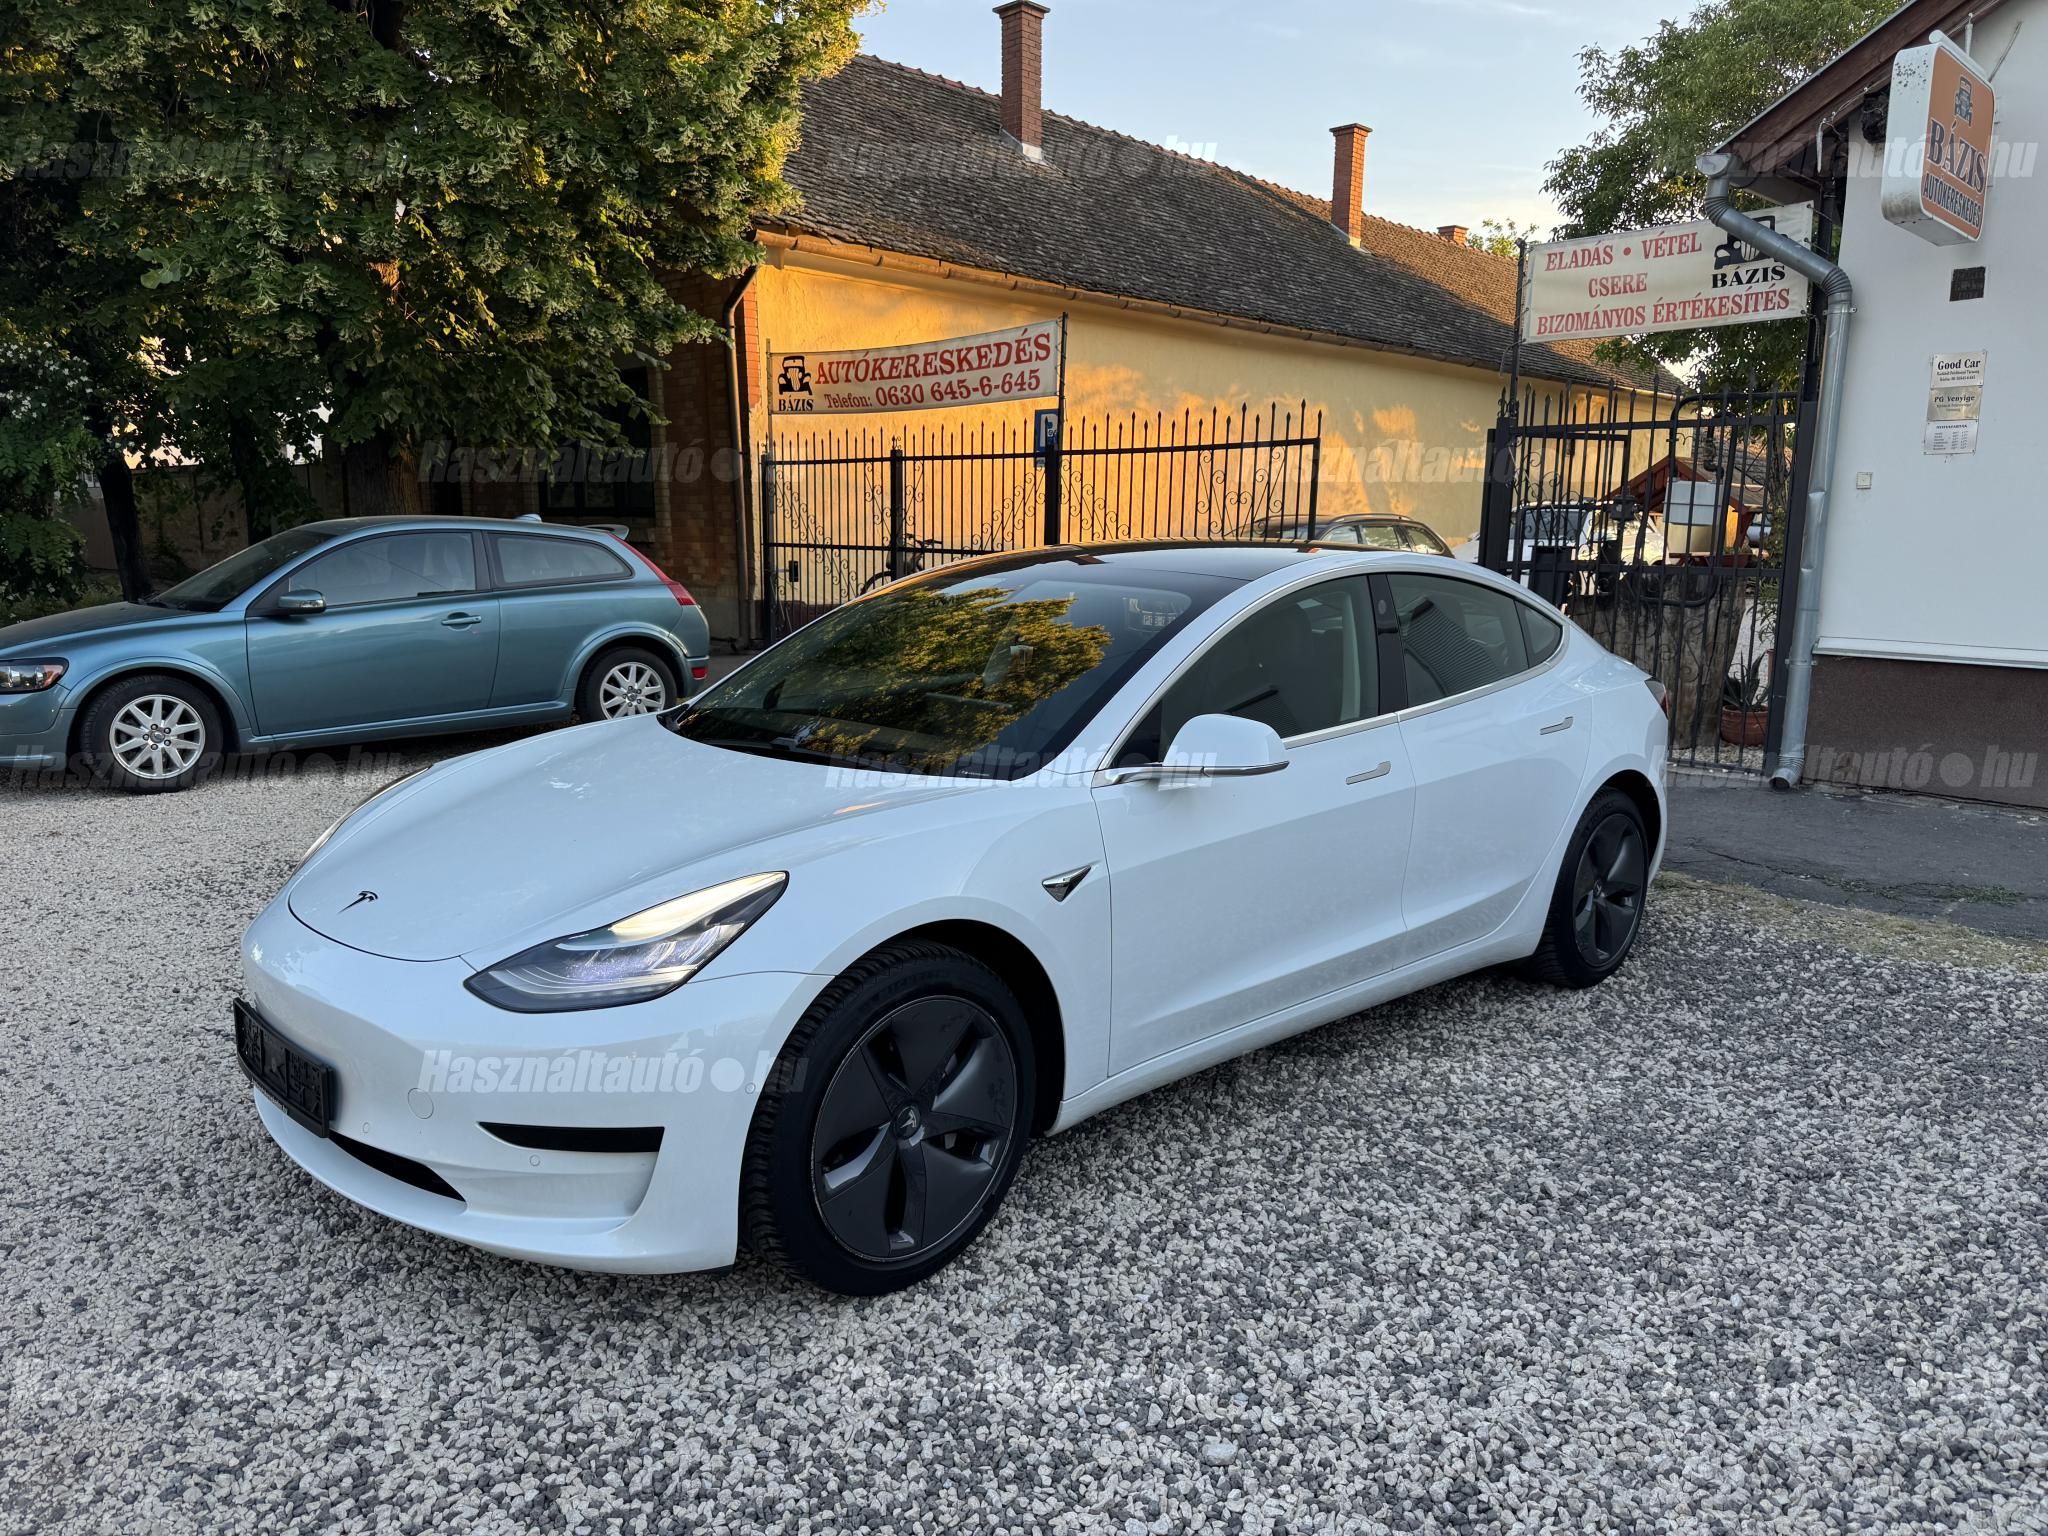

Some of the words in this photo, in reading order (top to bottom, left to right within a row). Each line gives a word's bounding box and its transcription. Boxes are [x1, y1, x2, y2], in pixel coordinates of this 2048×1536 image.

[1928, 117, 1986, 194] BÁZIS
[1544, 239, 1614, 272] ELADÁS
[1641, 230, 1703, 260] VÉTEL
[1588, 273, 1648, 298] CSERE
[1712, 265, 1786, 289] BÁZIS
[1536, 304, 1646, 336] BIZOMÁNYOS
[1652, 283, 1790, 324] ÉRTÉKESÍTÉS
[814, 328, 1051, 385] AUTÓKERESKEDÉS
[1937, 359, 1961, 371] Good
[1964, 359, 1981, 369] Car
[778, 396, 814, 412] BÁZIS
[824, 393, 872, 410] Telefon:
[876, 383, 925, 407] 0630
[930, 369, 1041, 402] 645-6-645
